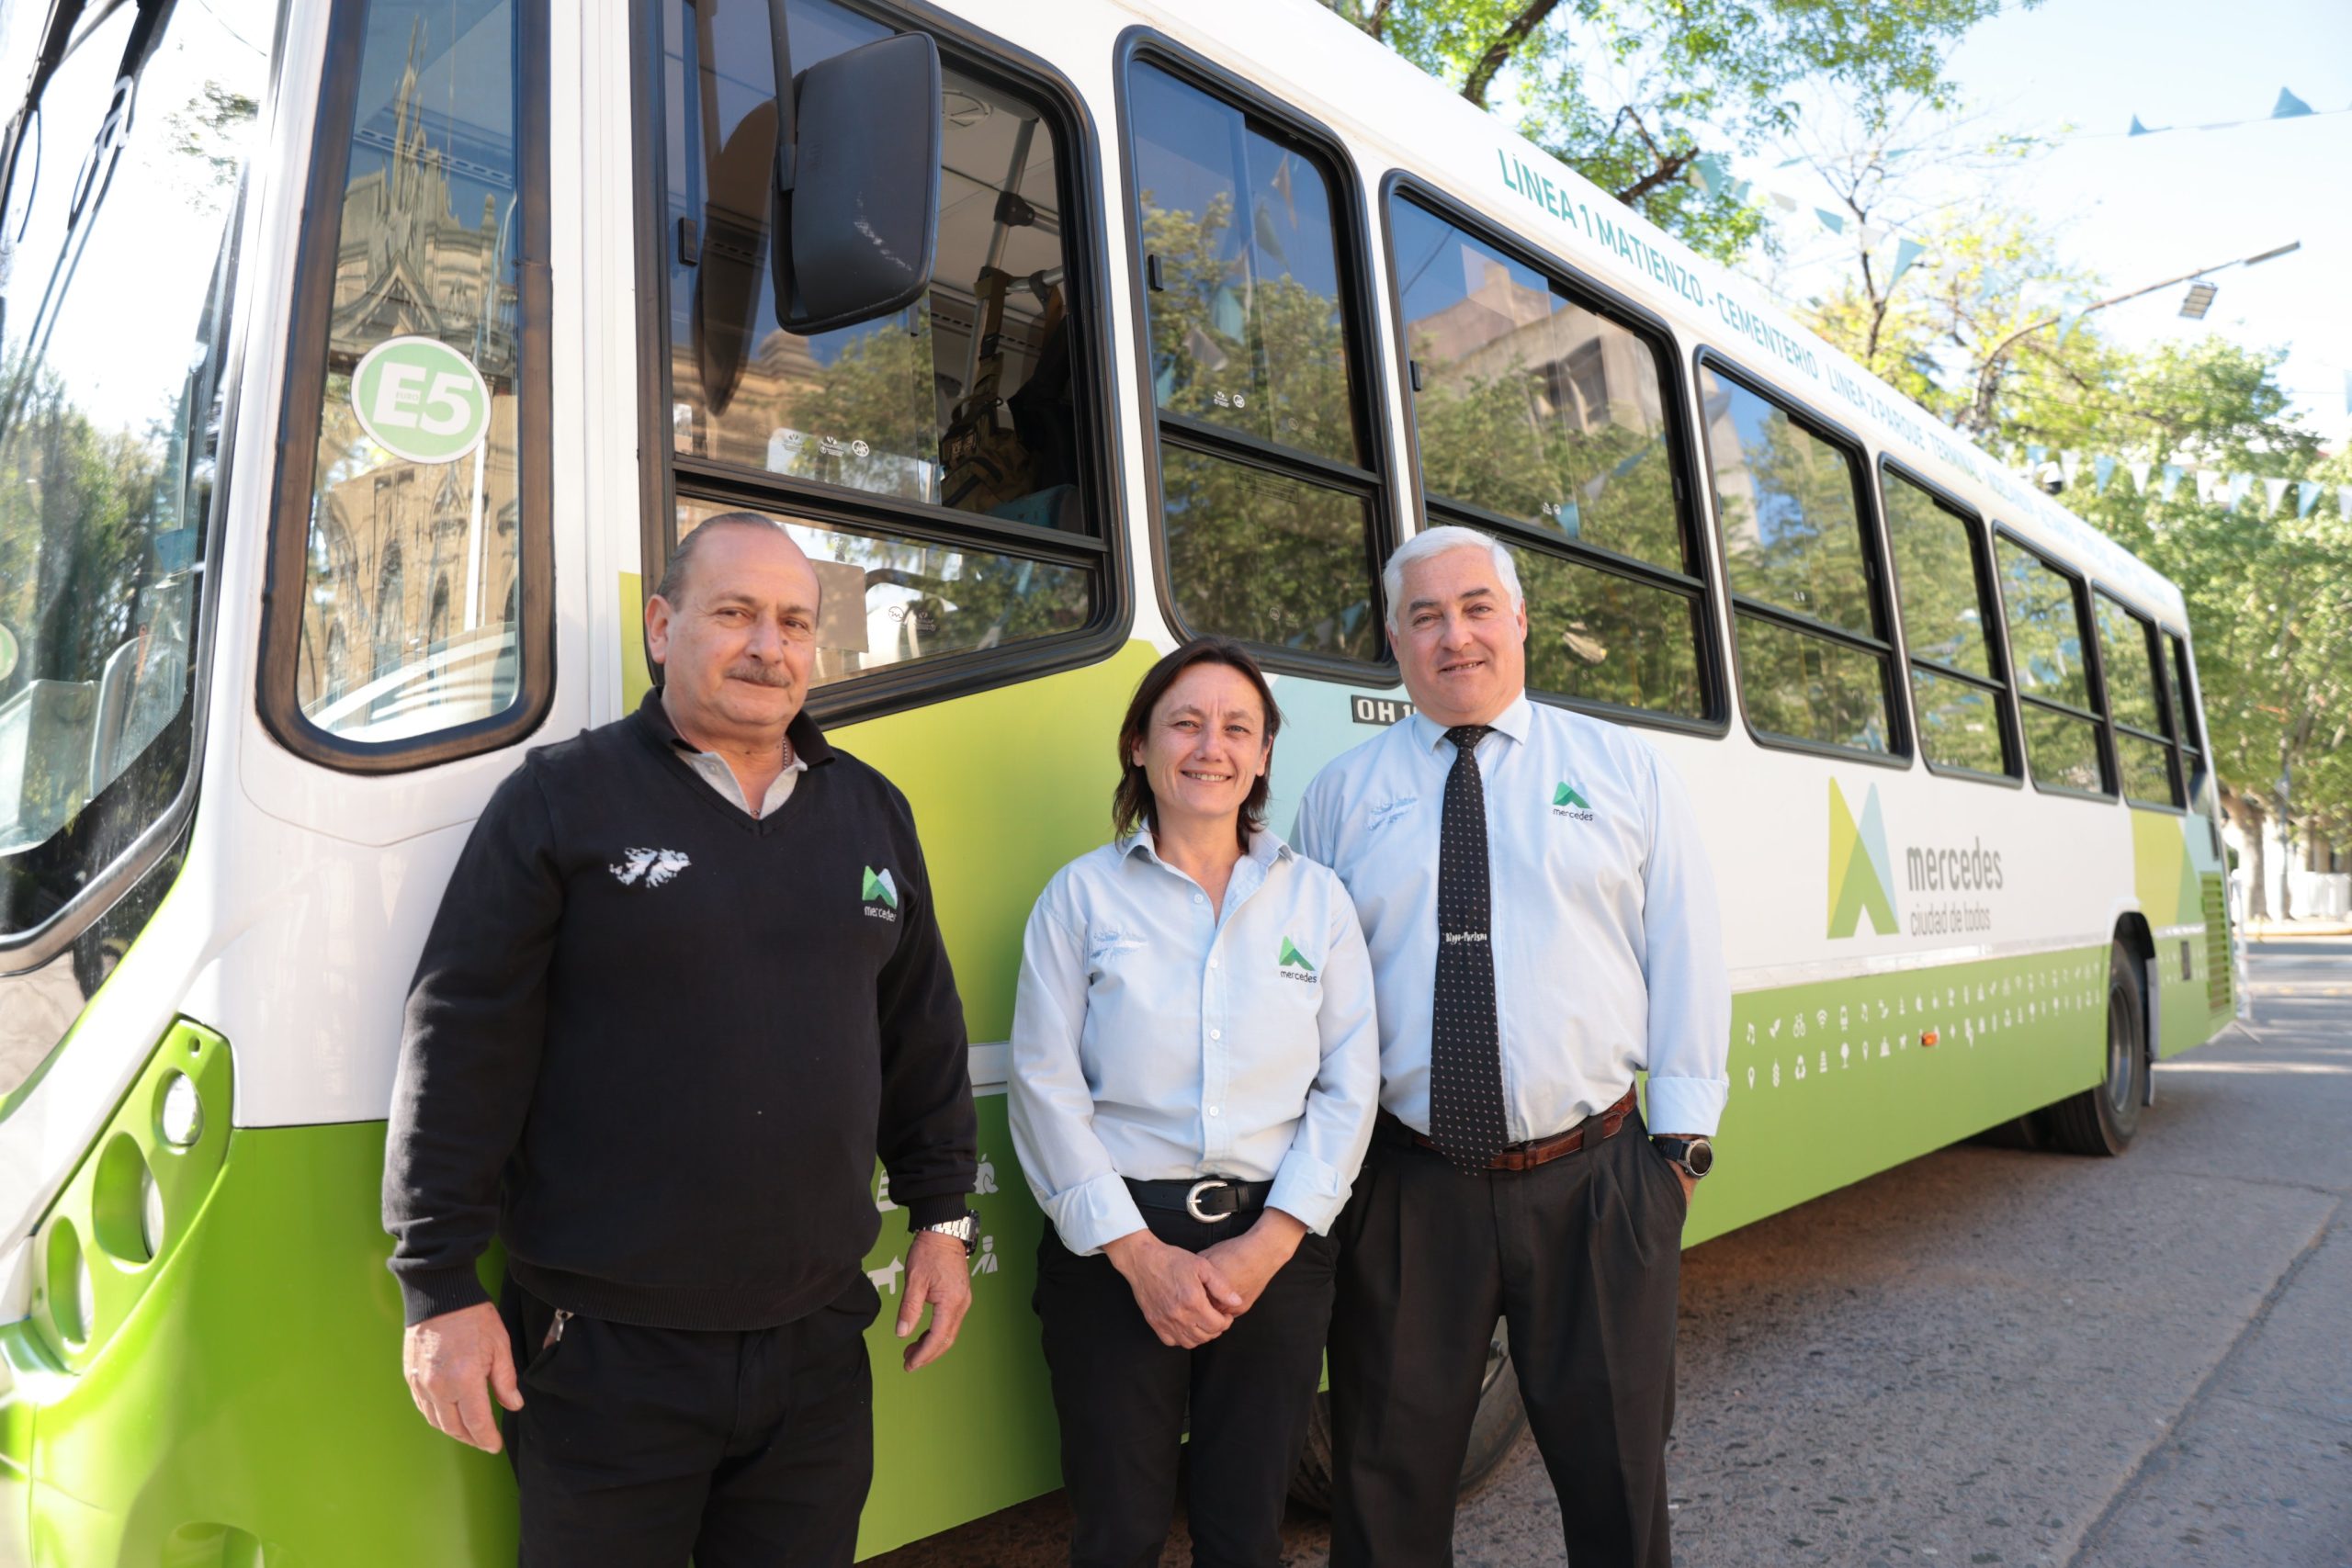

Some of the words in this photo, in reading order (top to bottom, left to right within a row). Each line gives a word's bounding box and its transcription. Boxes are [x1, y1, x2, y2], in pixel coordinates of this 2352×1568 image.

[1578, 204, 1593, 239] 1
[1594, 211, 1704, 308] MATIENZO
[1716, 291, 1819, 380] CEMENTERIO
[372, 361, 474, 436] E5
[395, 390, 420, 402] EURO
[1357, 699, 1396, 723] OH
[1402, 704, 1418, 718] 1
[1553, 808, 1594, 821] mercedes
[1906, 835, 2004, 891] mercedes
[1911, 901, 1949, 937] ciudad
[1950, 901, 1963, 934] de
[1963, 900, 1992, 932] todos
[1280, 970, 1318, 983] mercedes
